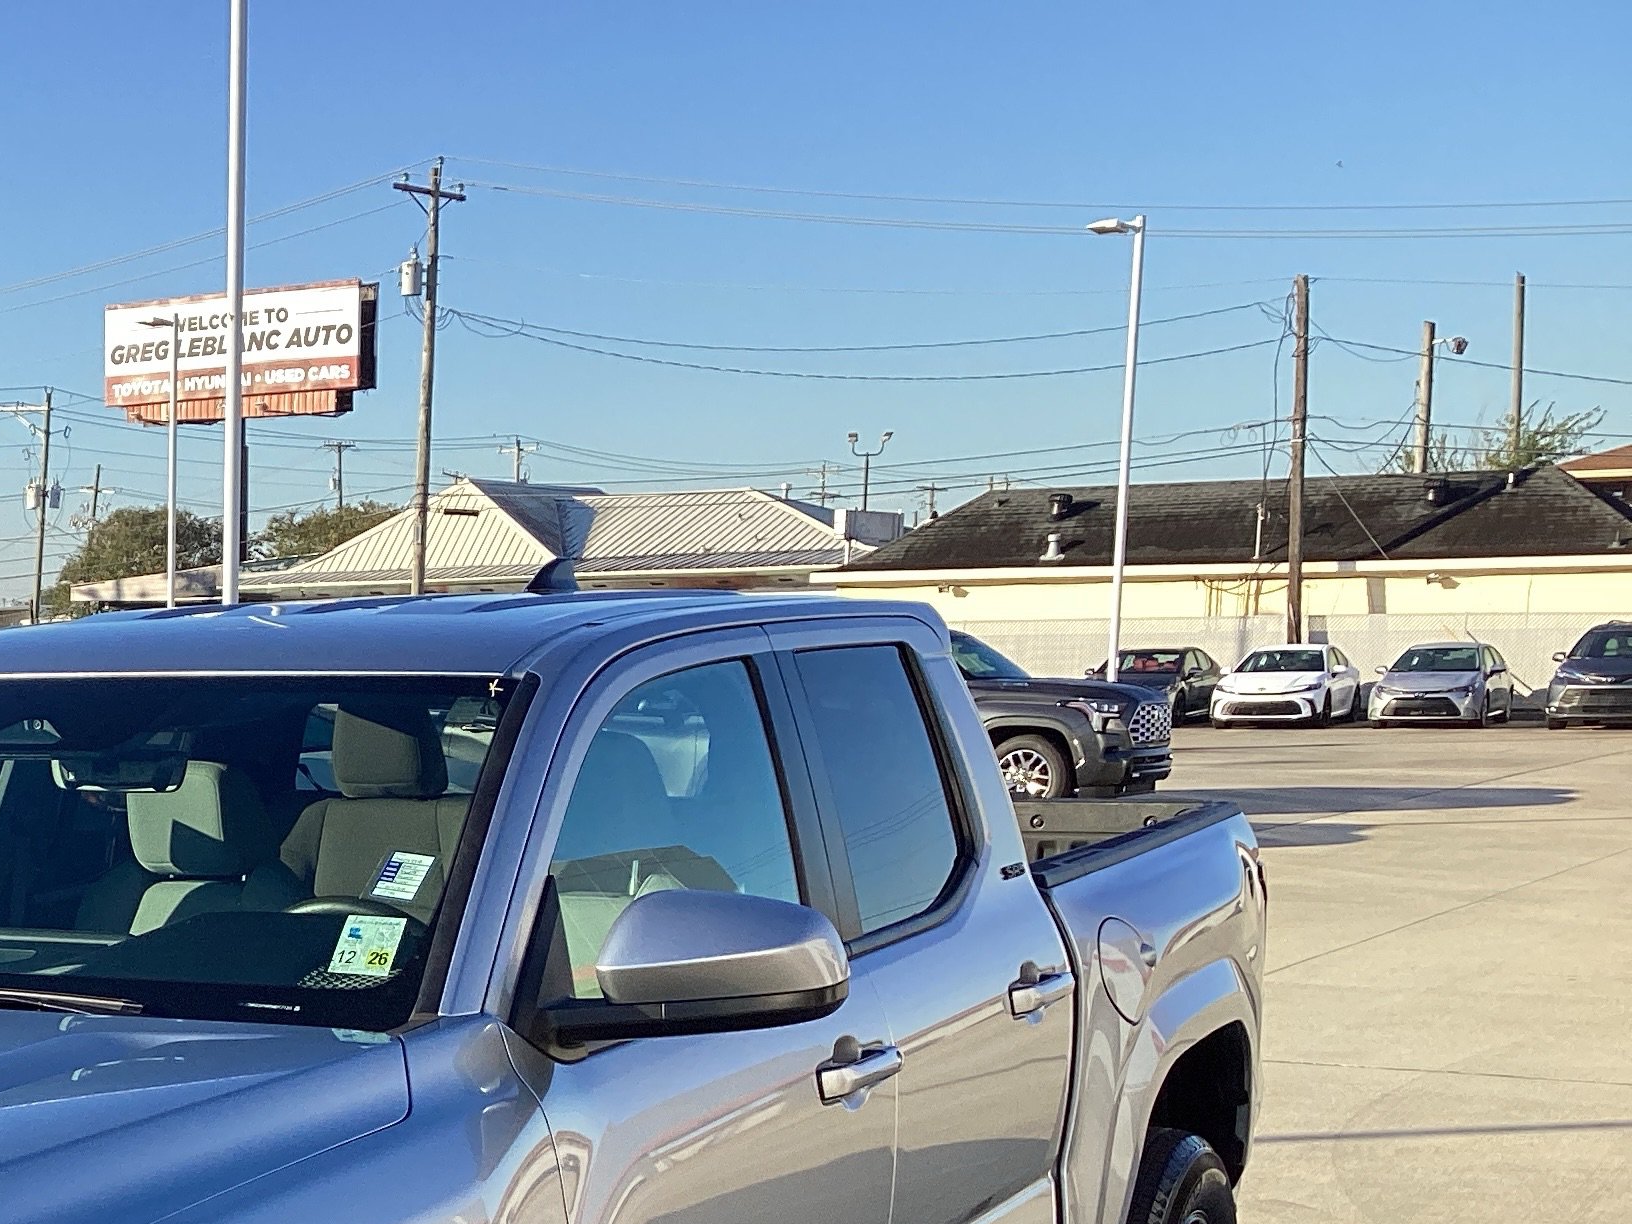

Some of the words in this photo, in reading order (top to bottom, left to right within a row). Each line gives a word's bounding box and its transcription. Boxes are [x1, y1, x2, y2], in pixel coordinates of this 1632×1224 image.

[264, 307, 289, 323] TO
[110, 340, 170, 365] GREG
[176, 330, 282, 358] LEBLNC
[285, 323, 353, 349] AUTO
[111, 378, 171, 398] TOYOTA
[184, 372, 252, 392] HYUNAI
[264, 366, 305, 385] USED
[308, 363, 350, 381] CARS
[337, 950, 357, 964] 12
[367, 951, 389, 966] 26
